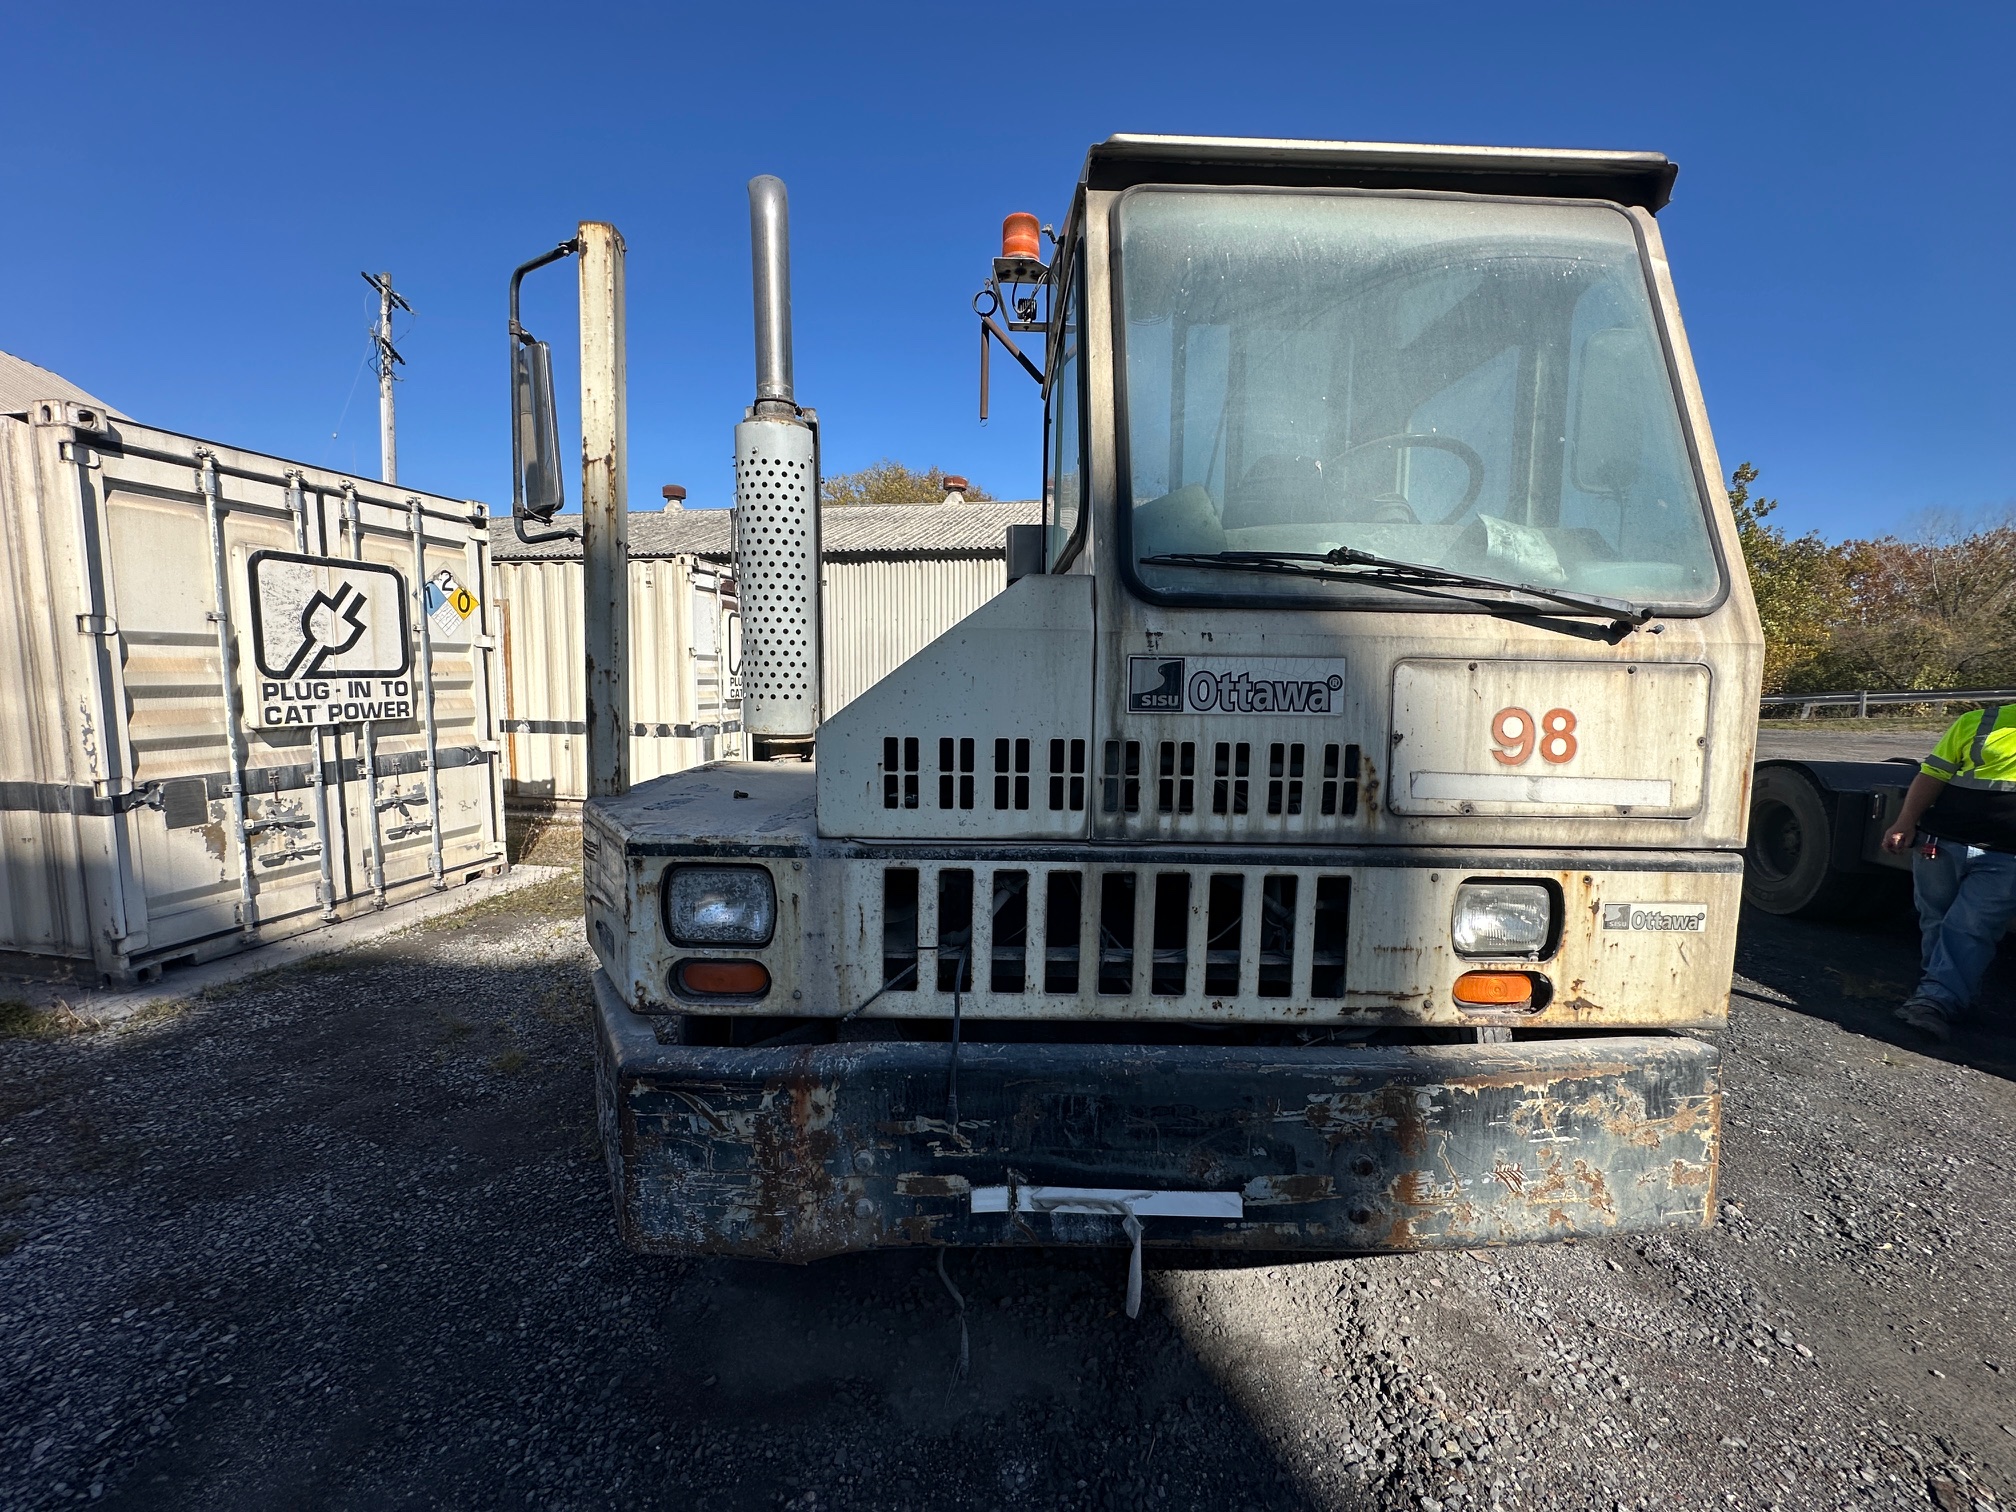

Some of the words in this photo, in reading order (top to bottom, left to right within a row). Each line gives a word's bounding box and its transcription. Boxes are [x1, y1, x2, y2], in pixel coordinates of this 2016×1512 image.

[440, 569, 454, 591] 2
[425, 586, 434, 609] 1
[457, 591, 471, 613] 0
[380, 680, 409, 697] TO
[327, 700, 410, 722] POWER
[1141, 694, 1179, 707] SISU
[1489, 706, 1577, 766] 98
[1608, 920, 1627, 928] SISU
